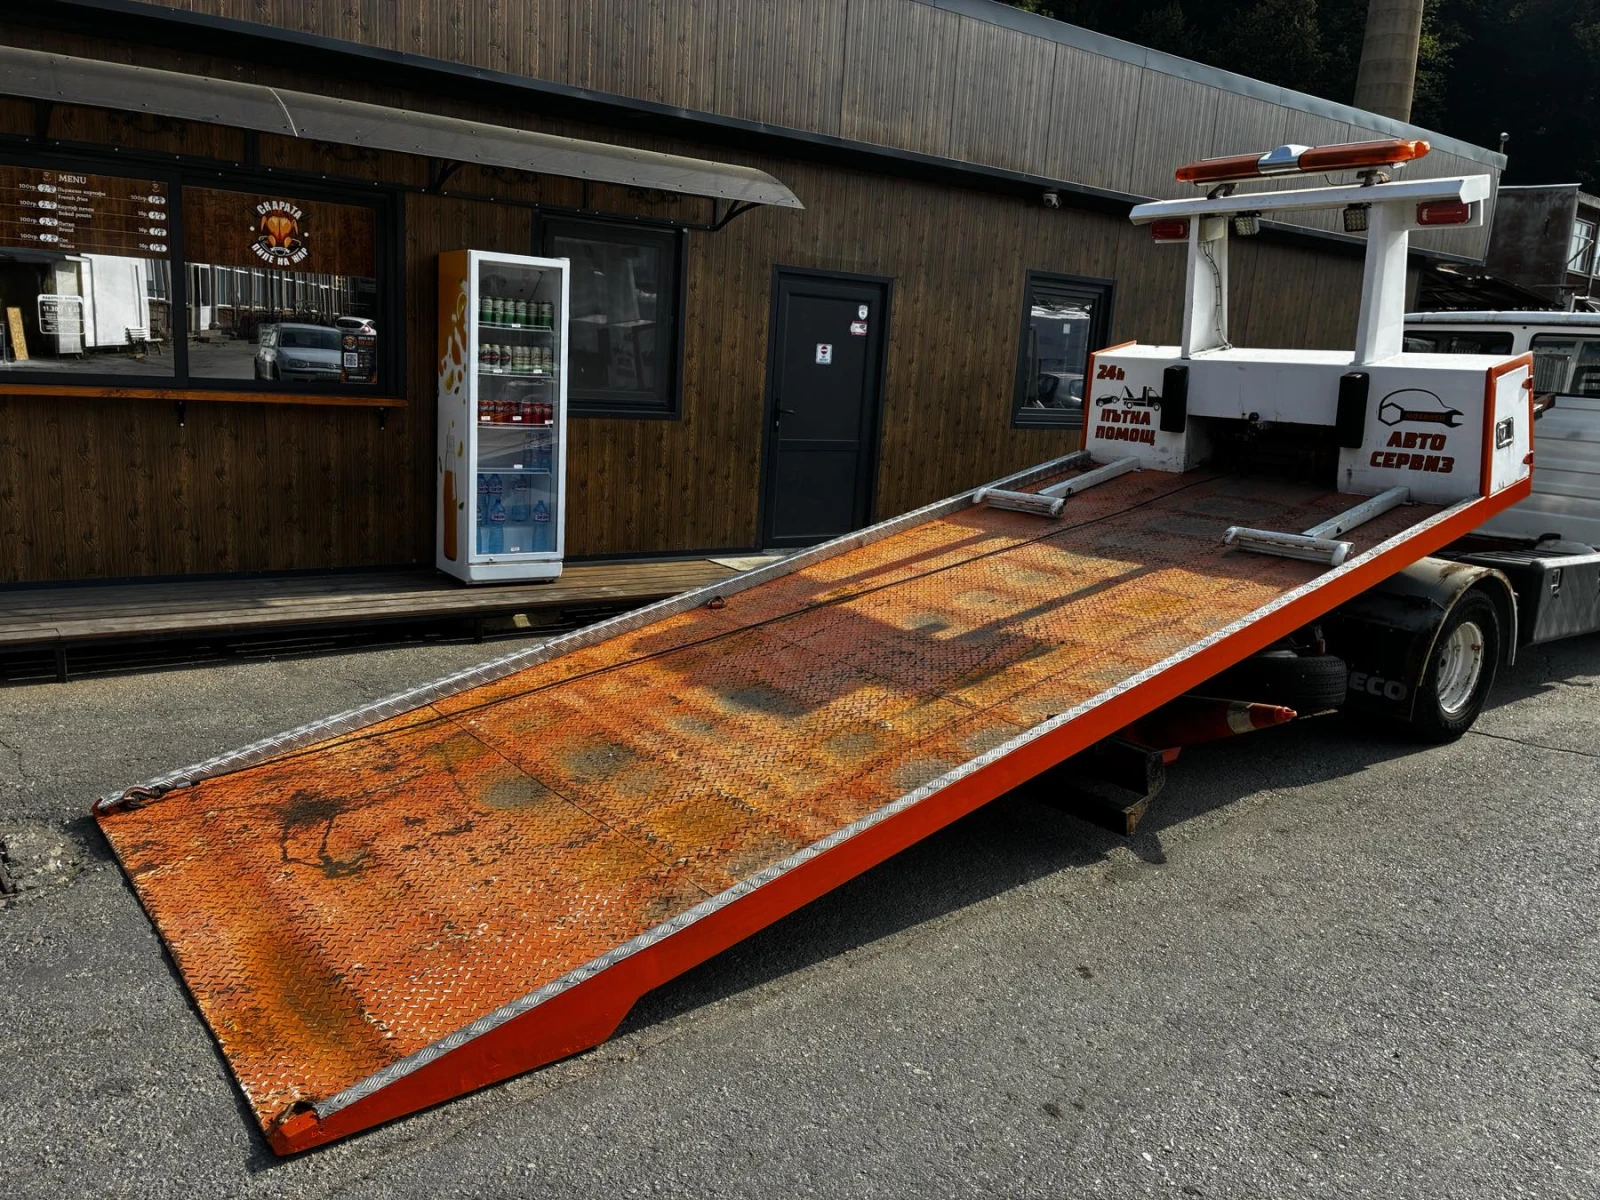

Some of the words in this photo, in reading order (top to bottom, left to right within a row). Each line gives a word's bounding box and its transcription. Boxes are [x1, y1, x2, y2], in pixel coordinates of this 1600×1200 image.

[58, 174, 87, 184] MENU
[256, 200, 303, 220] СКАРАТА
[251, 243, 275, 264] ПИЛЕ
[277, 257, 290, 266] НА
[291, 247, 309, 264] ЖАР
[1096, 364, 1126, 381] 24h
[1100, 408, 1151, 426] ПЪТНА
[1095, 425, 1156, 446] ПОМОЩ
[1386, 431, 1447, 451] АВТО
[1369, 450, 1455, 474] СЕРВИЗ
[1347, 671, 1408, 701] ECO
